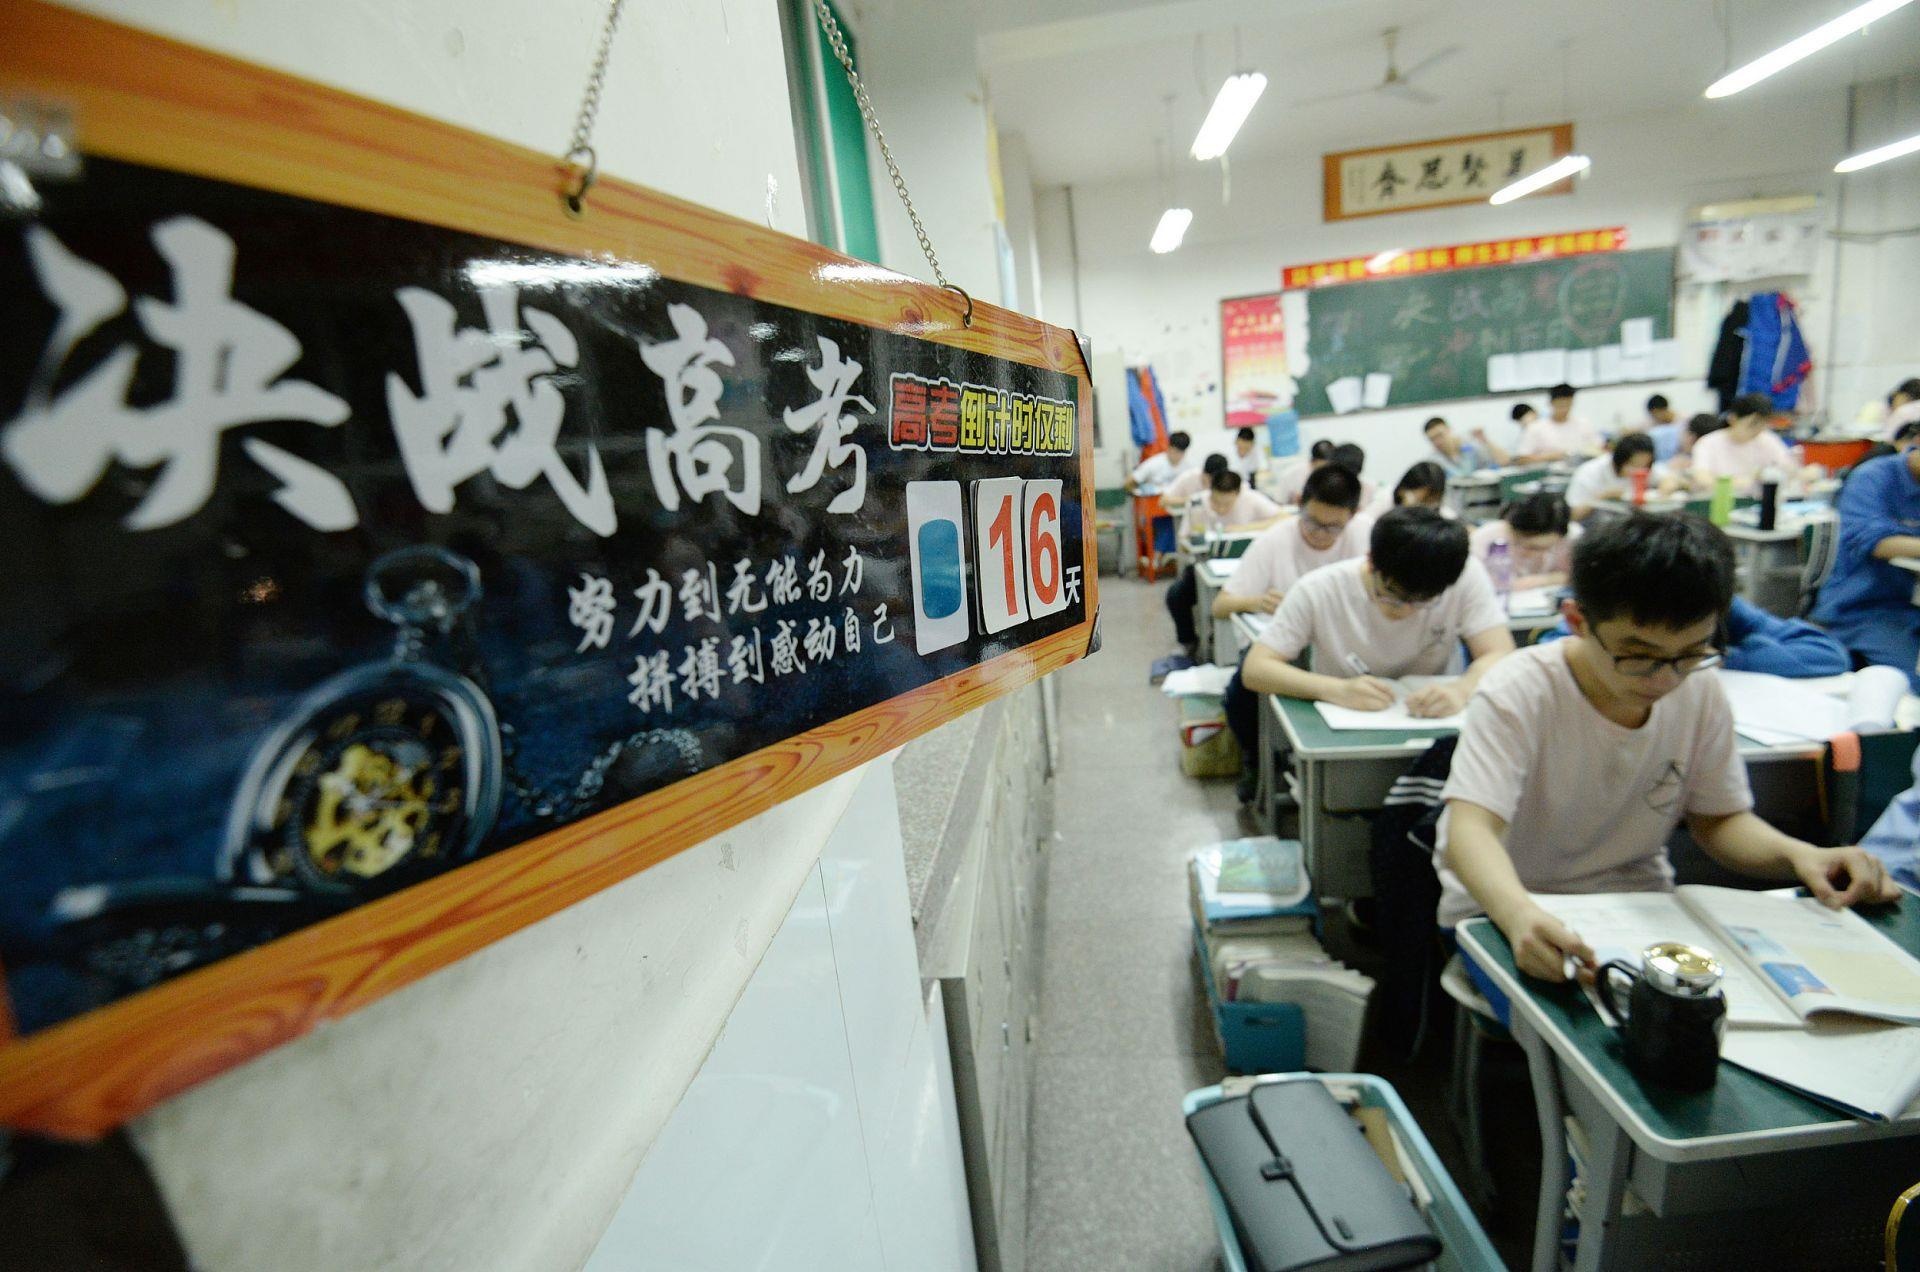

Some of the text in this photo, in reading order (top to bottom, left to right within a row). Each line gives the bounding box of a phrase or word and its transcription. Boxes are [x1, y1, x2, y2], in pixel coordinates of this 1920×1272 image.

[3, 215, 876, 537] 决战高考
[890, 375, 1075, 454] 高考倒计时仅剩
[568, 545, 863, 653] 努力到无能为力
[989, 492, 1060, 617] 16
[627, 602, 895, 714] 拼搏到感动自己
